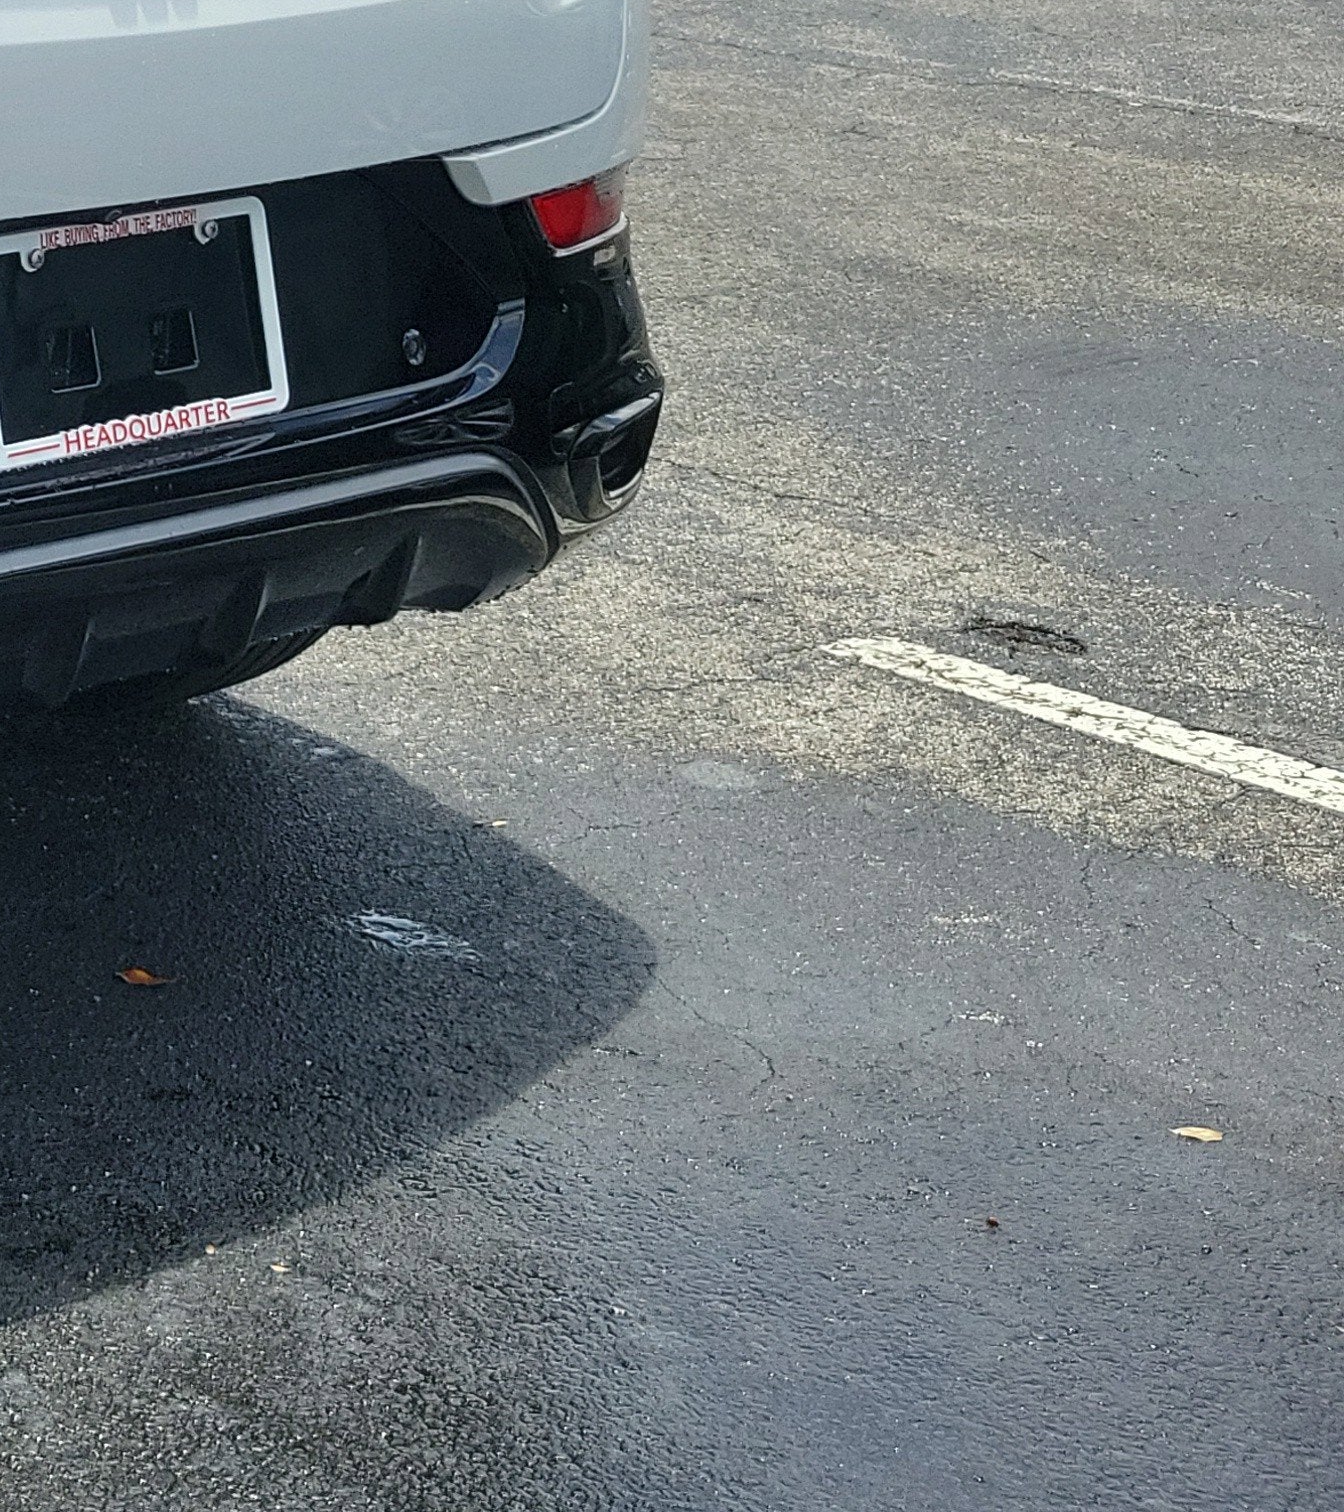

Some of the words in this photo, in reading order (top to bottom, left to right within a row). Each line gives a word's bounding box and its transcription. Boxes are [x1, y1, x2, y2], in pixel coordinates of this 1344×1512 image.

[40, 231, 60, 249] LIKE
[64, 225, 99, 246] BUYING
[104, 219, 130, 238] FROM
[134, 216, 151, 232] THE
[155, 209, 198, 230] FACTORY!
[64, 401, 231, 453] HEADQUARTER
